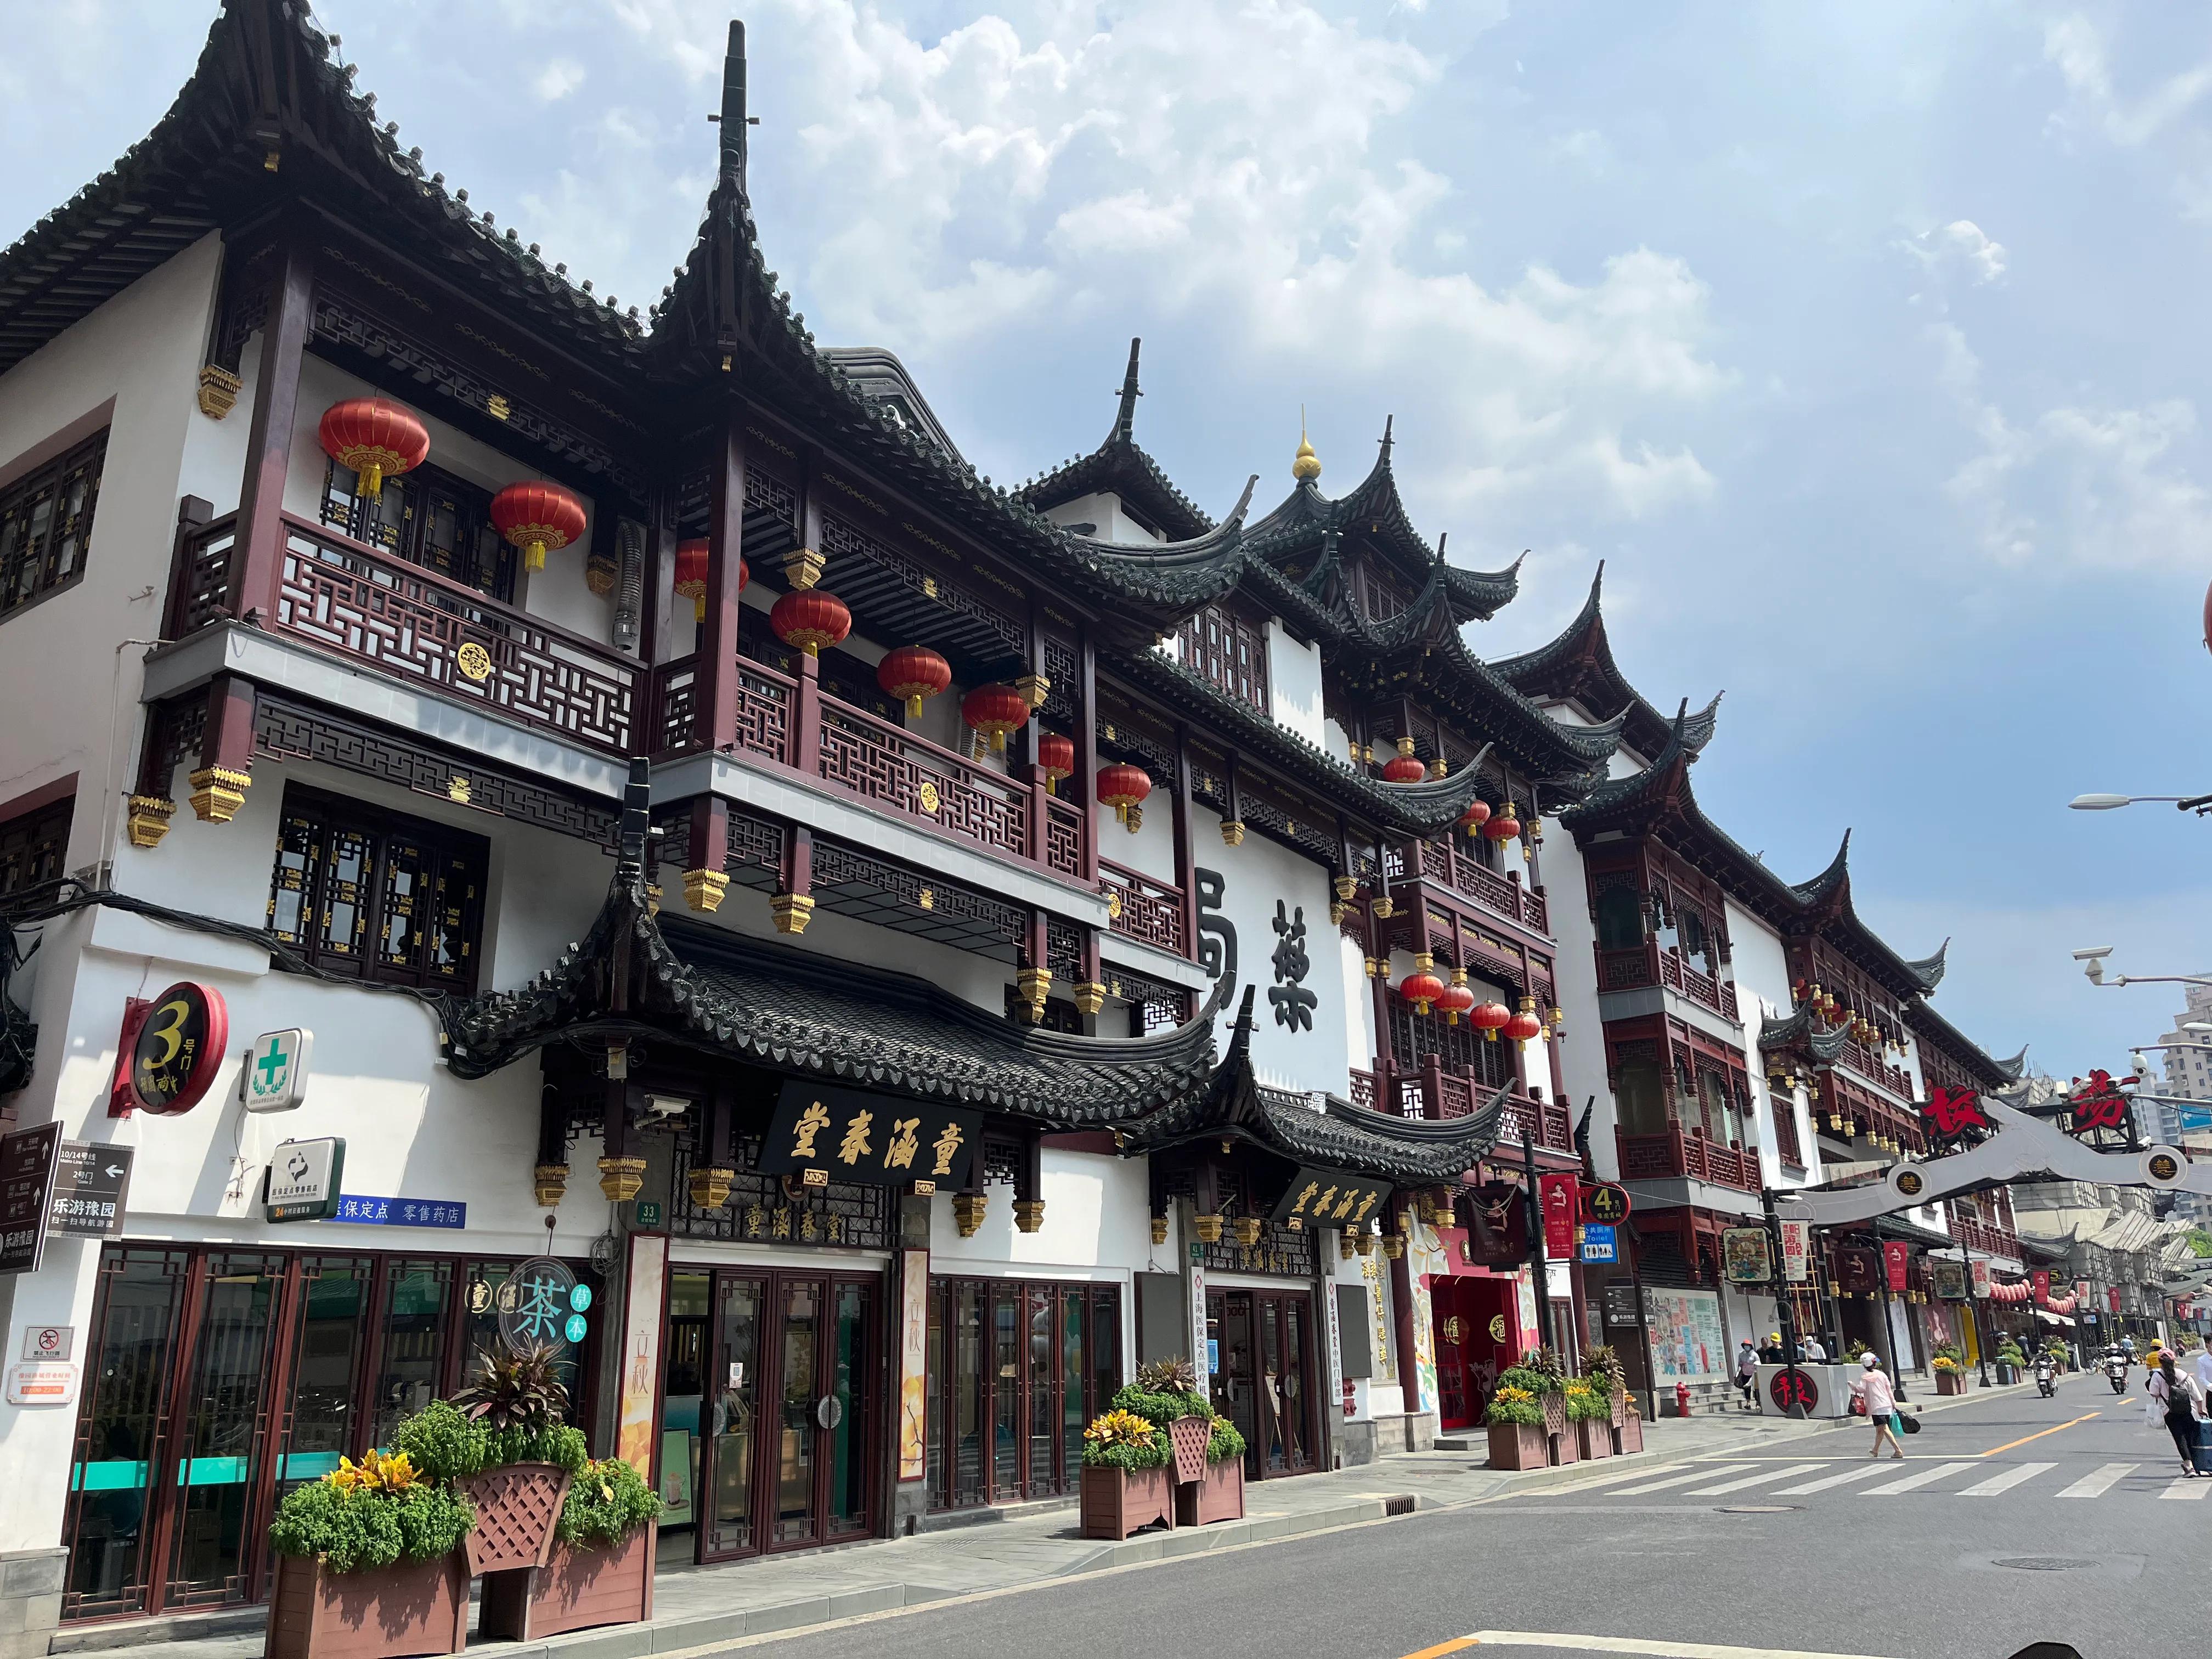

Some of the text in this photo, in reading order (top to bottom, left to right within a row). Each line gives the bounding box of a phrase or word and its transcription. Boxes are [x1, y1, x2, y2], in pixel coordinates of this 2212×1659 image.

[142, 1000, 189, 1070] 3
[180, 1038, 195, 1071] 号门
[791, 1101, 964, 1176] 童涵春堂
[60, 1150, 96, 1161] 10/14号线
[72, 1171, 93, 1180] 2号门
[52, 1198, 115, 1217] 乐游豫园
[402, 1204, 459, 1223] 零售药店
[644, 1205, 654, 1217] 33
[1291, 1181, 1378, 1222] 童涵春堂
[1595, 1188, 1612, 1211] 4
[51, 1216, 114, 1228] 扫一扫导航游园
[745, 1204, 843, 1241] 童涵春堂
[512, 1274, 566, 1339] 茶
[909, 1299, 922, 1352] 立秋
[631, 1329, 652, 1395] 立秋
